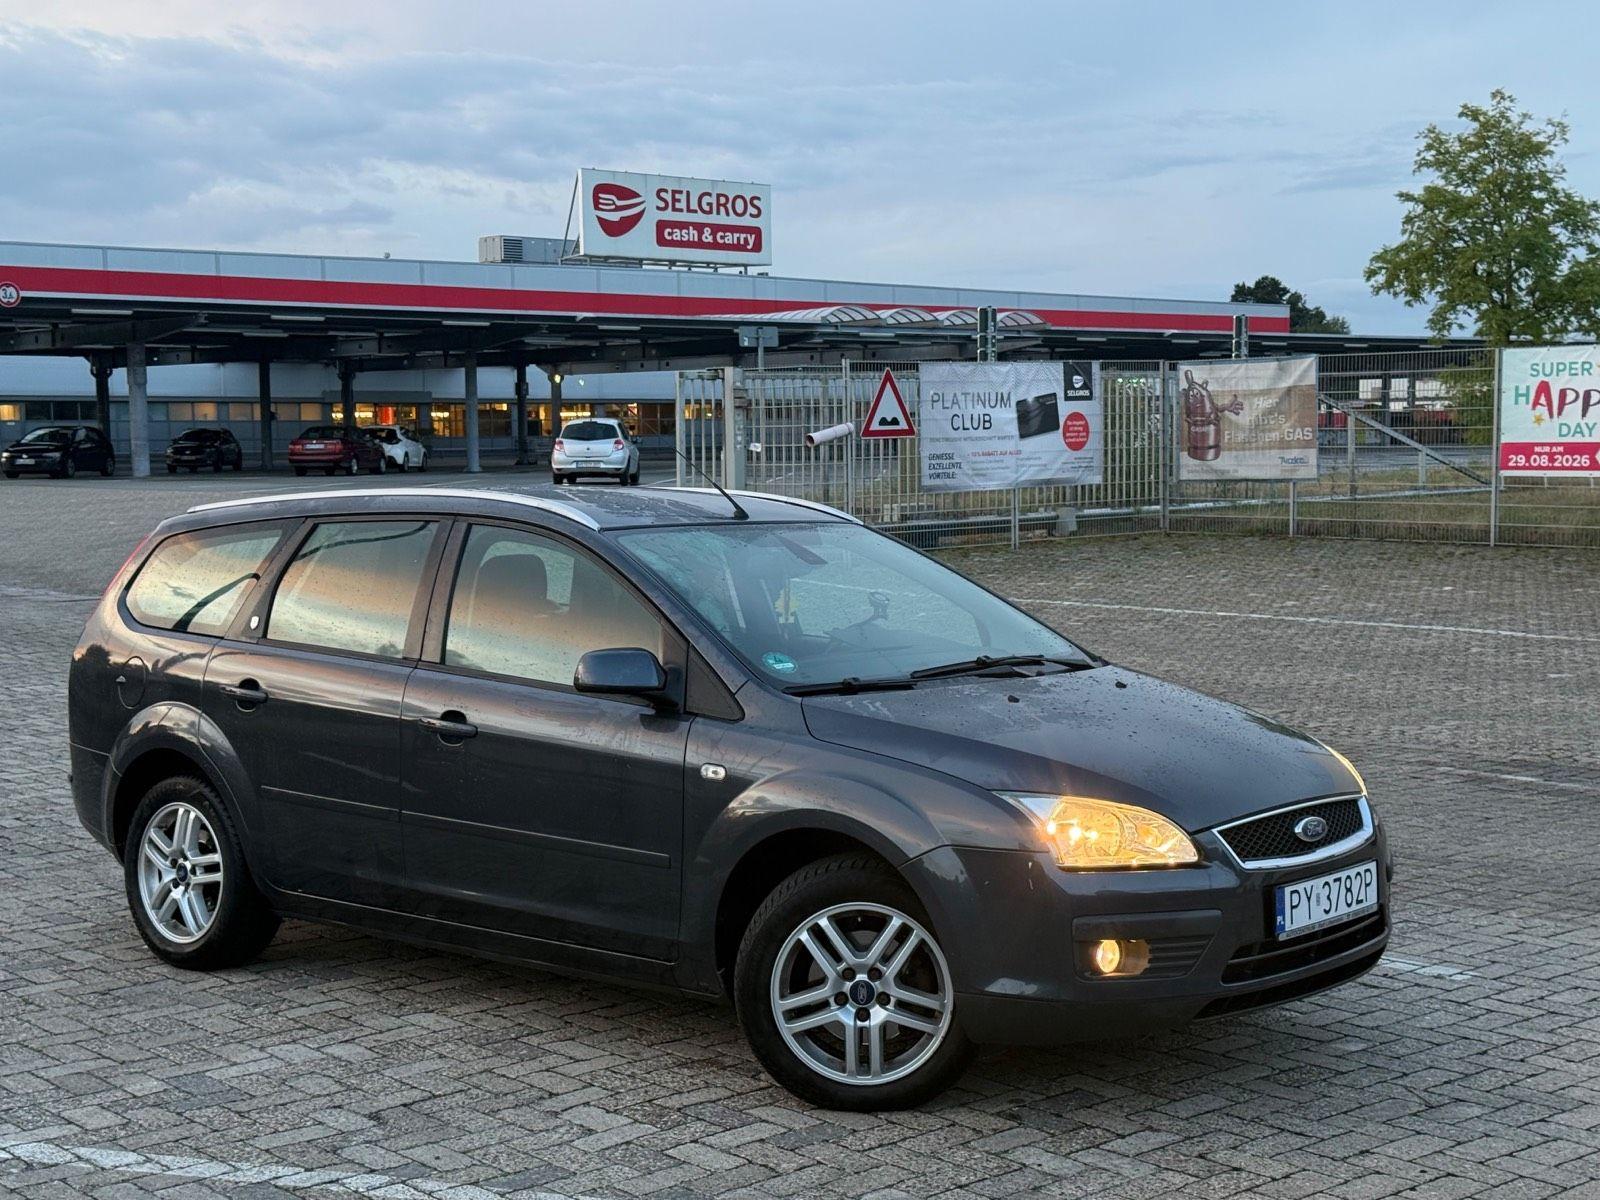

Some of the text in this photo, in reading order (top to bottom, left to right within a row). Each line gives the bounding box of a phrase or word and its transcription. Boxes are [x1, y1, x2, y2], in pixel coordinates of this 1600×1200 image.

[655, 187, 762, 219] SELGROS
[663, 226, 756, 249] cash & carry
[1530, 361, 1593, 377] SUPER
[931, 391, 1012, 410] PLATINUM
[1067, 389, 1090, 397] SELGROS
[1254, 396, 1280, 408] Hier
[951, 413, 993, 431] CLUB
[1558, 422, 1597, 438] DAY
[928, 452, 955, 461] GENIESSE
[1534, 445, 1564, 453] NUR AM
[928, 461, 962, 470] EXZELLENTE
[1508, 454, 1590, 467] 29.08.2026
[1290, 884, 1314, 925] PY
[1322, 868, 1373, 915] 3782P
